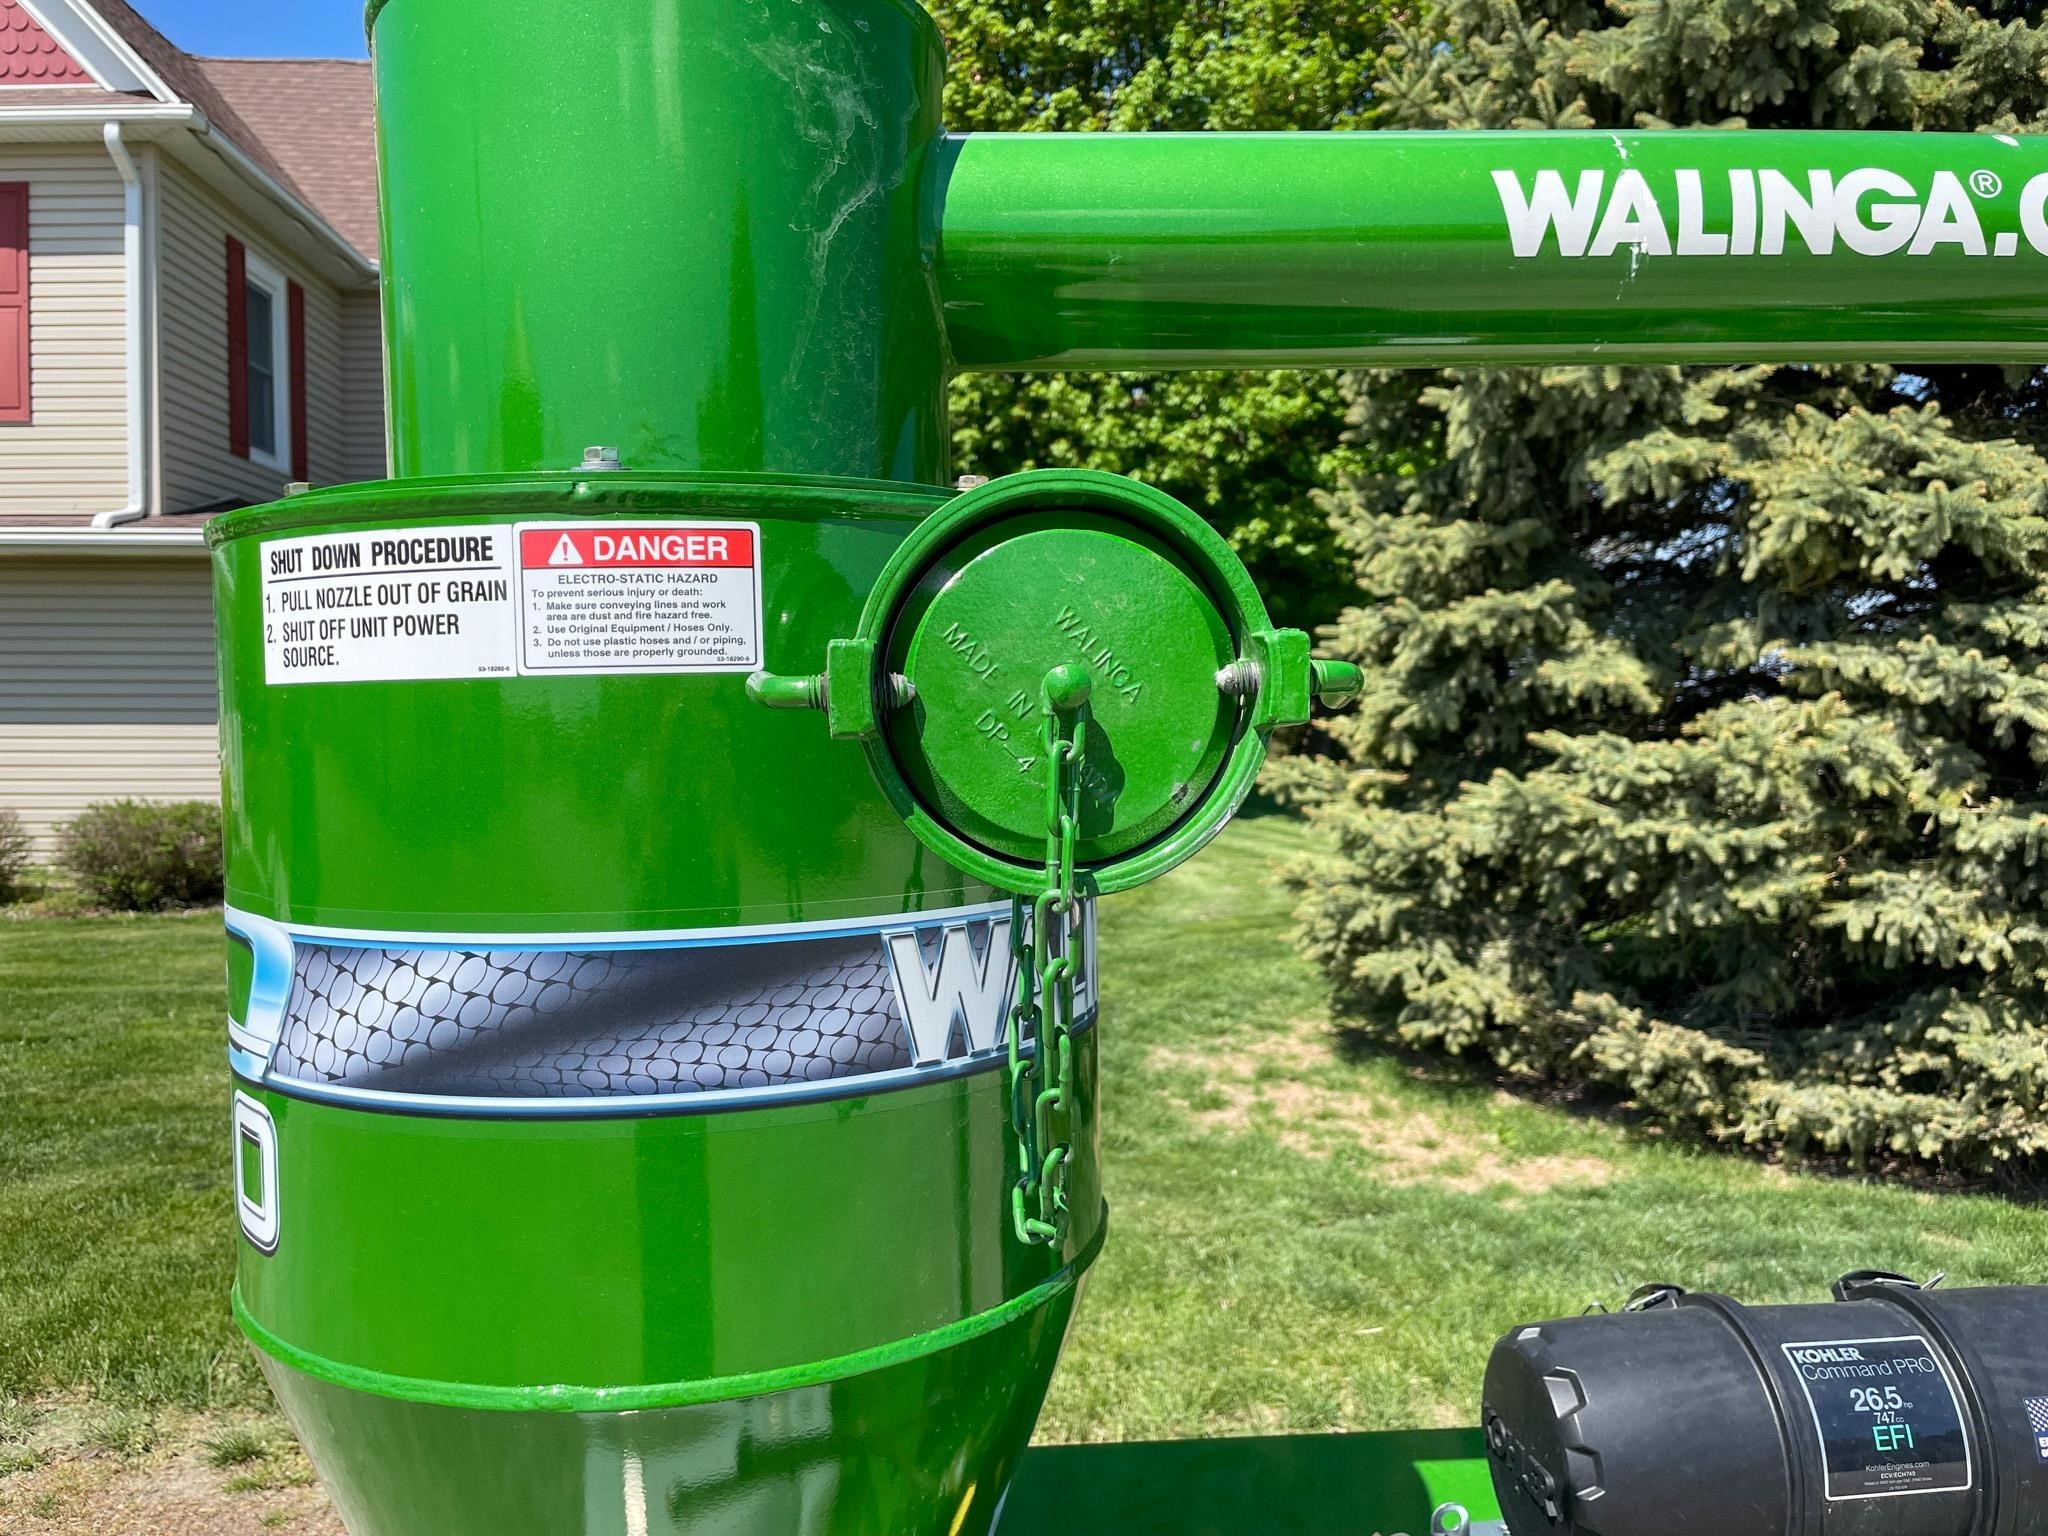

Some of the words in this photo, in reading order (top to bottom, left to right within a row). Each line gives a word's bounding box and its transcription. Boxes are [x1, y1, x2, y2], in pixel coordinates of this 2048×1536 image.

[270, 548, 303, 575] SHUT
[312, 542, 361, 570] DOWN
[371, 536, 493, 566] PROCEDURE
[593, 535, 728, 561] DANGER
[558, 574, 664, 585] ELECTRO-STATIC
[667, 573, 718, 583] HAZARD
[266, 593, 276, 613] 1.
[281, 590, 312, 612] PULL
[316, 585, 373, 609] NOZZLE
[378, 582, 412, 605] OUT
[417, 581, 444, 604] OF
[446, 579, 508, 603] GRAIN
[532, 589, 544, 598] To
[547, 589, 584, 599] prevent
[587, 588, 624, 597] serious
[627, 587, 655, 598] injury
[672, 587, 703, 596] death:
[532, 602, 541, 611] 1.
[546, 601, 572, 610] Make
[575, 602, 597, 610] sure
[599, 600, 651, 611] conveying
[654, 600, 678, 609] lines
[681, 600, 699, 609] and
[702, 600, 726, 609] work
[546, 613, 568, 621] area
[570, 613, 587, 621] are
[589, 611, 611, 620] dust
[614, 611, 633, 620] and
[635, 610, 652, 619] fire
[654, 610, 688, 619] hazard
[691, 610, 713, 619] free.
[267, 623, 277, 643] 2.
[282, 620, 315, 643] SHUT
[319, 618, 346, 640] OFF
[351, 616, 388, 639] UNIT
[393, 613, 460, 637] POWER
[532, 625, 541, 634] 2.
[547, 625, 566, 634] Use
[568, 623, 608, 635] Original
[611, 623, 665, 635] Equipment
[673, 623, 705, 632] Hoses
[707, 623, 734, 633] Only.
[533, 638, 542, 647] 3.
[547, 638, 561, 647] Do
[564, 638, 581, 647] not
[583, 638, 601, 646] use
[603, 636, 637, 647] plastic
[639, 636, 670, 645] hoses
[672, 636, 691, 645] and
[713, 635, 747, 646] piping,
[283, 645, 340, 669] SOURCE.
[548, 649, 580, 658] unless
[583, 648, 611, 657] those
[614, 649, 630, 657] are
[632, 647, 674, 658] properly
[677, 646, 728, 658] grounded.
[943, 622, 1000, 684] MADE
[1006, 689, 1036, 721] IN
[1792, 1347, 1865, 1365] KOHLER
[1801, 1360, 1893, 1381] Command
[1893, 1357, 1936, 1375] PRO
[1872, 1424, 1914, 1451] EFI
